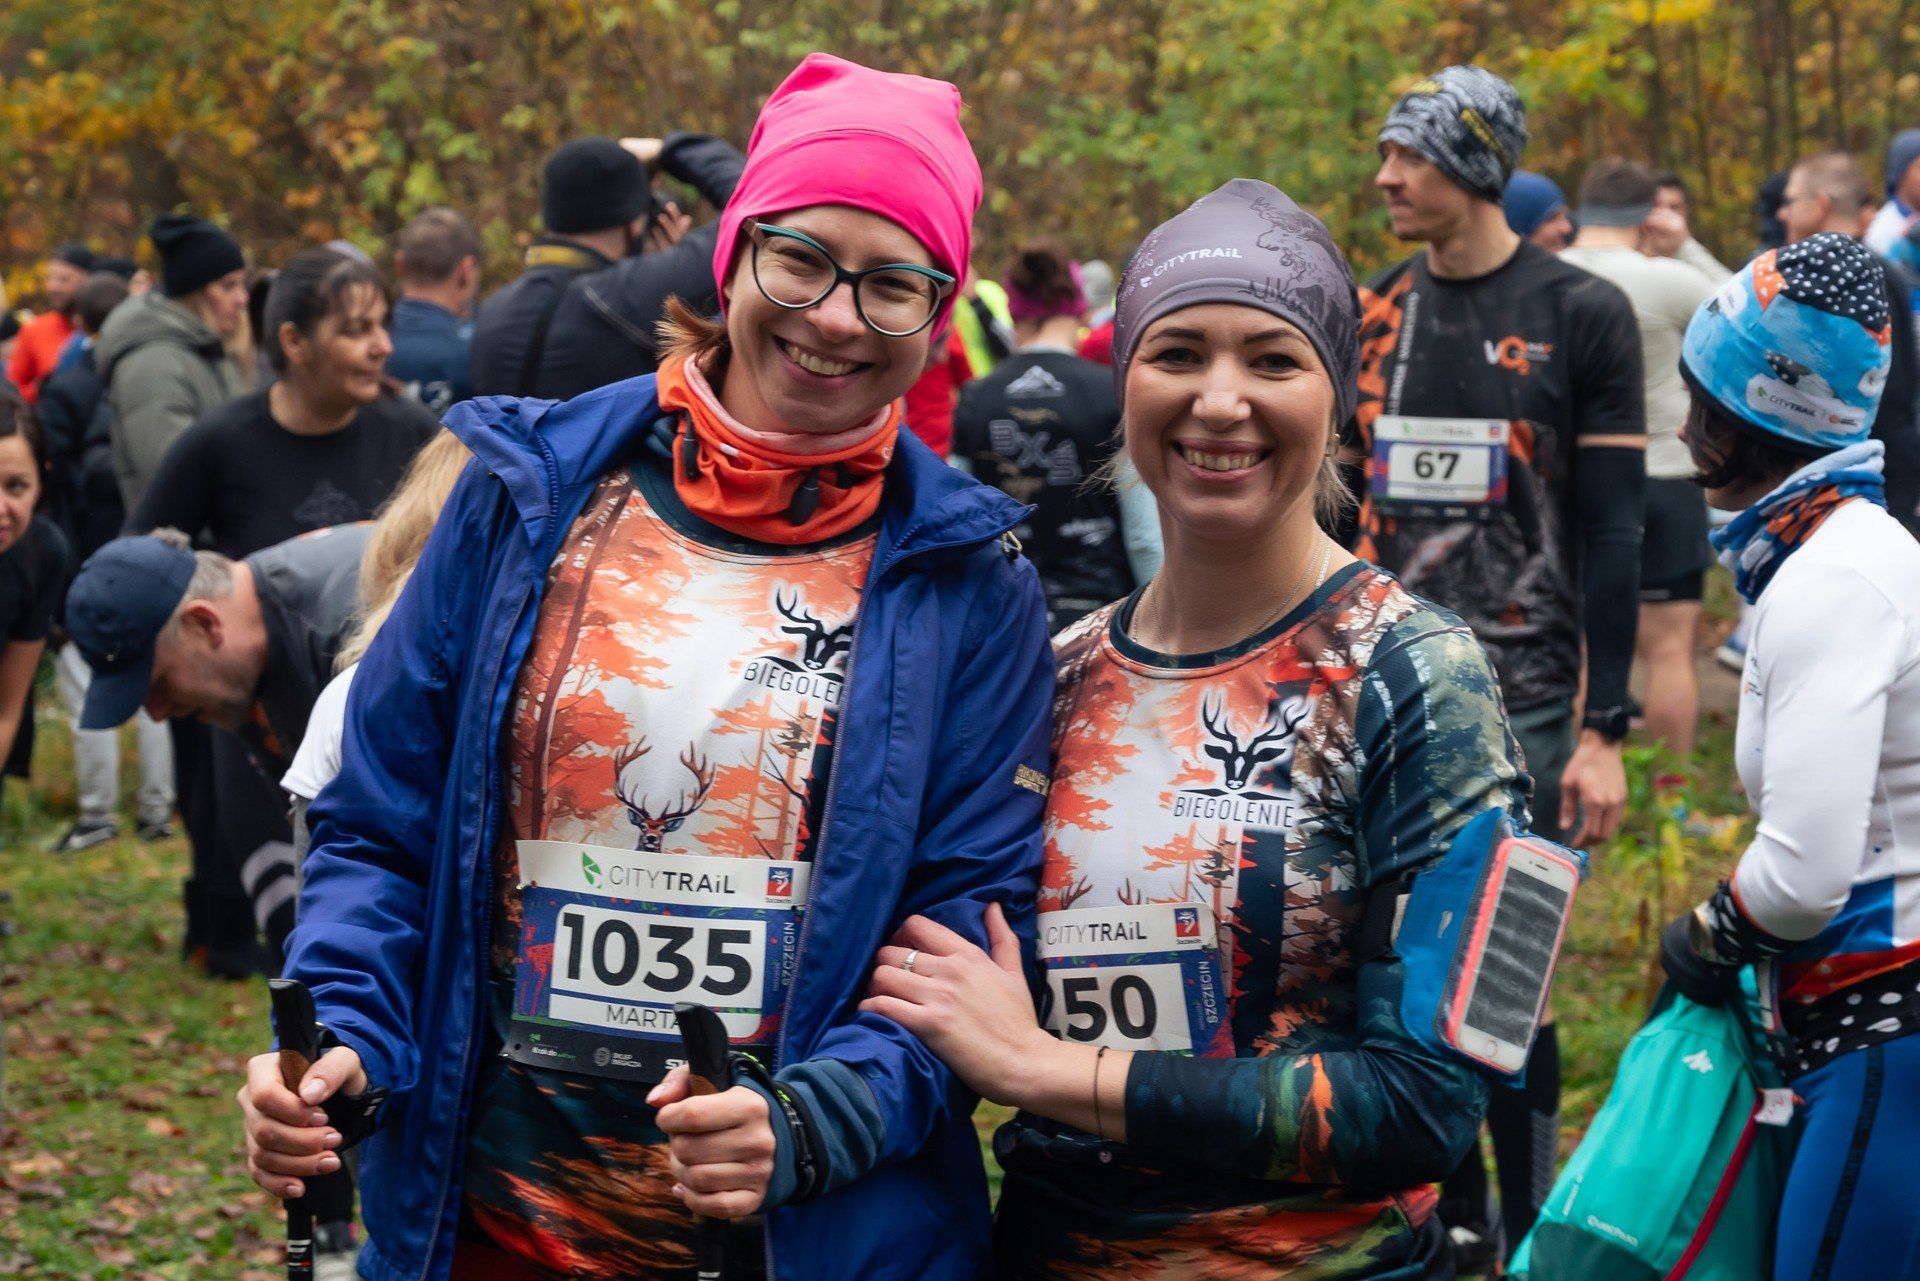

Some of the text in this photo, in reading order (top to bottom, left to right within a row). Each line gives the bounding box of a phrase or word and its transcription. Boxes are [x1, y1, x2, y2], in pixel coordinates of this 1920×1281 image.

[1414, 451, 1461, 479] 67
[743, 661, 844, 706] BIEGOLE
[1174, 796, 1295, 828] BIEGOLENIE
[561, 911, 753, 996] 1035
